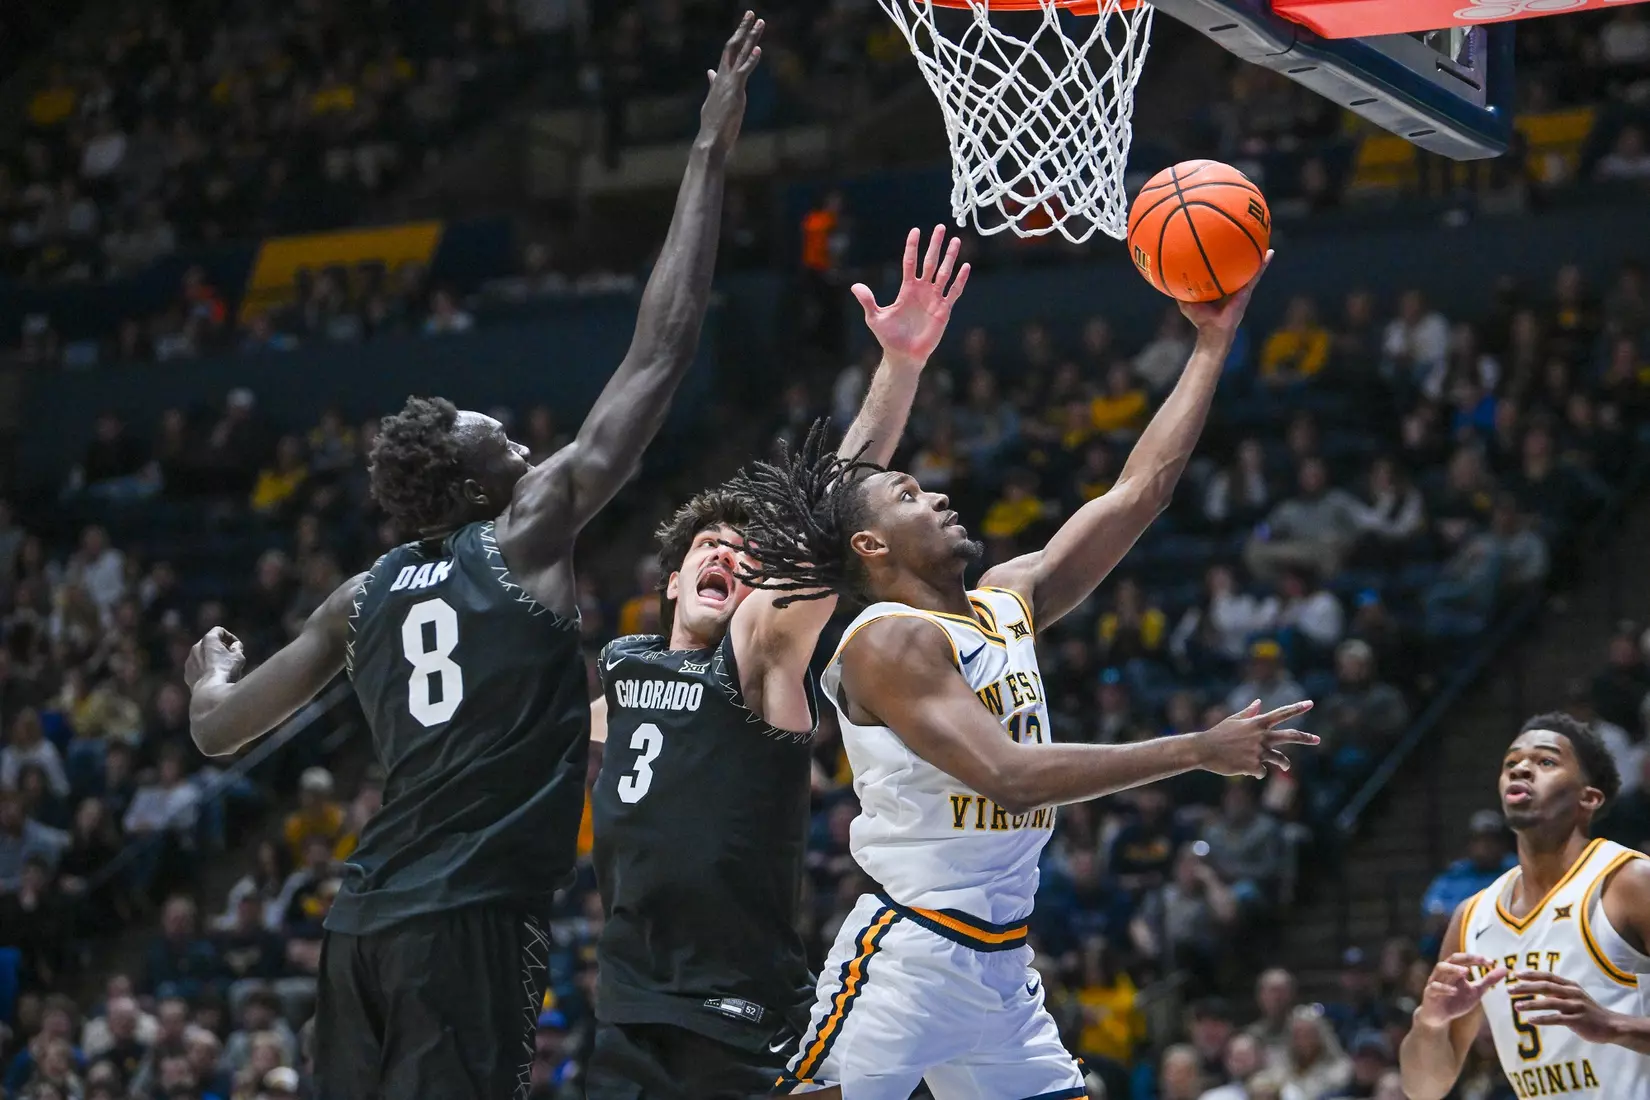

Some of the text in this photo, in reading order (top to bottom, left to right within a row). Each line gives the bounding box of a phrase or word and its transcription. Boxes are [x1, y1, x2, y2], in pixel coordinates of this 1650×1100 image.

[402, 598, 463, 727] 8
[614, 679, 704, 711] COLORADO
[617, 722, 664, 804] 3
[745, 1005, 756, 1016] 52
[1510, 994, 1542, 1062] 5
